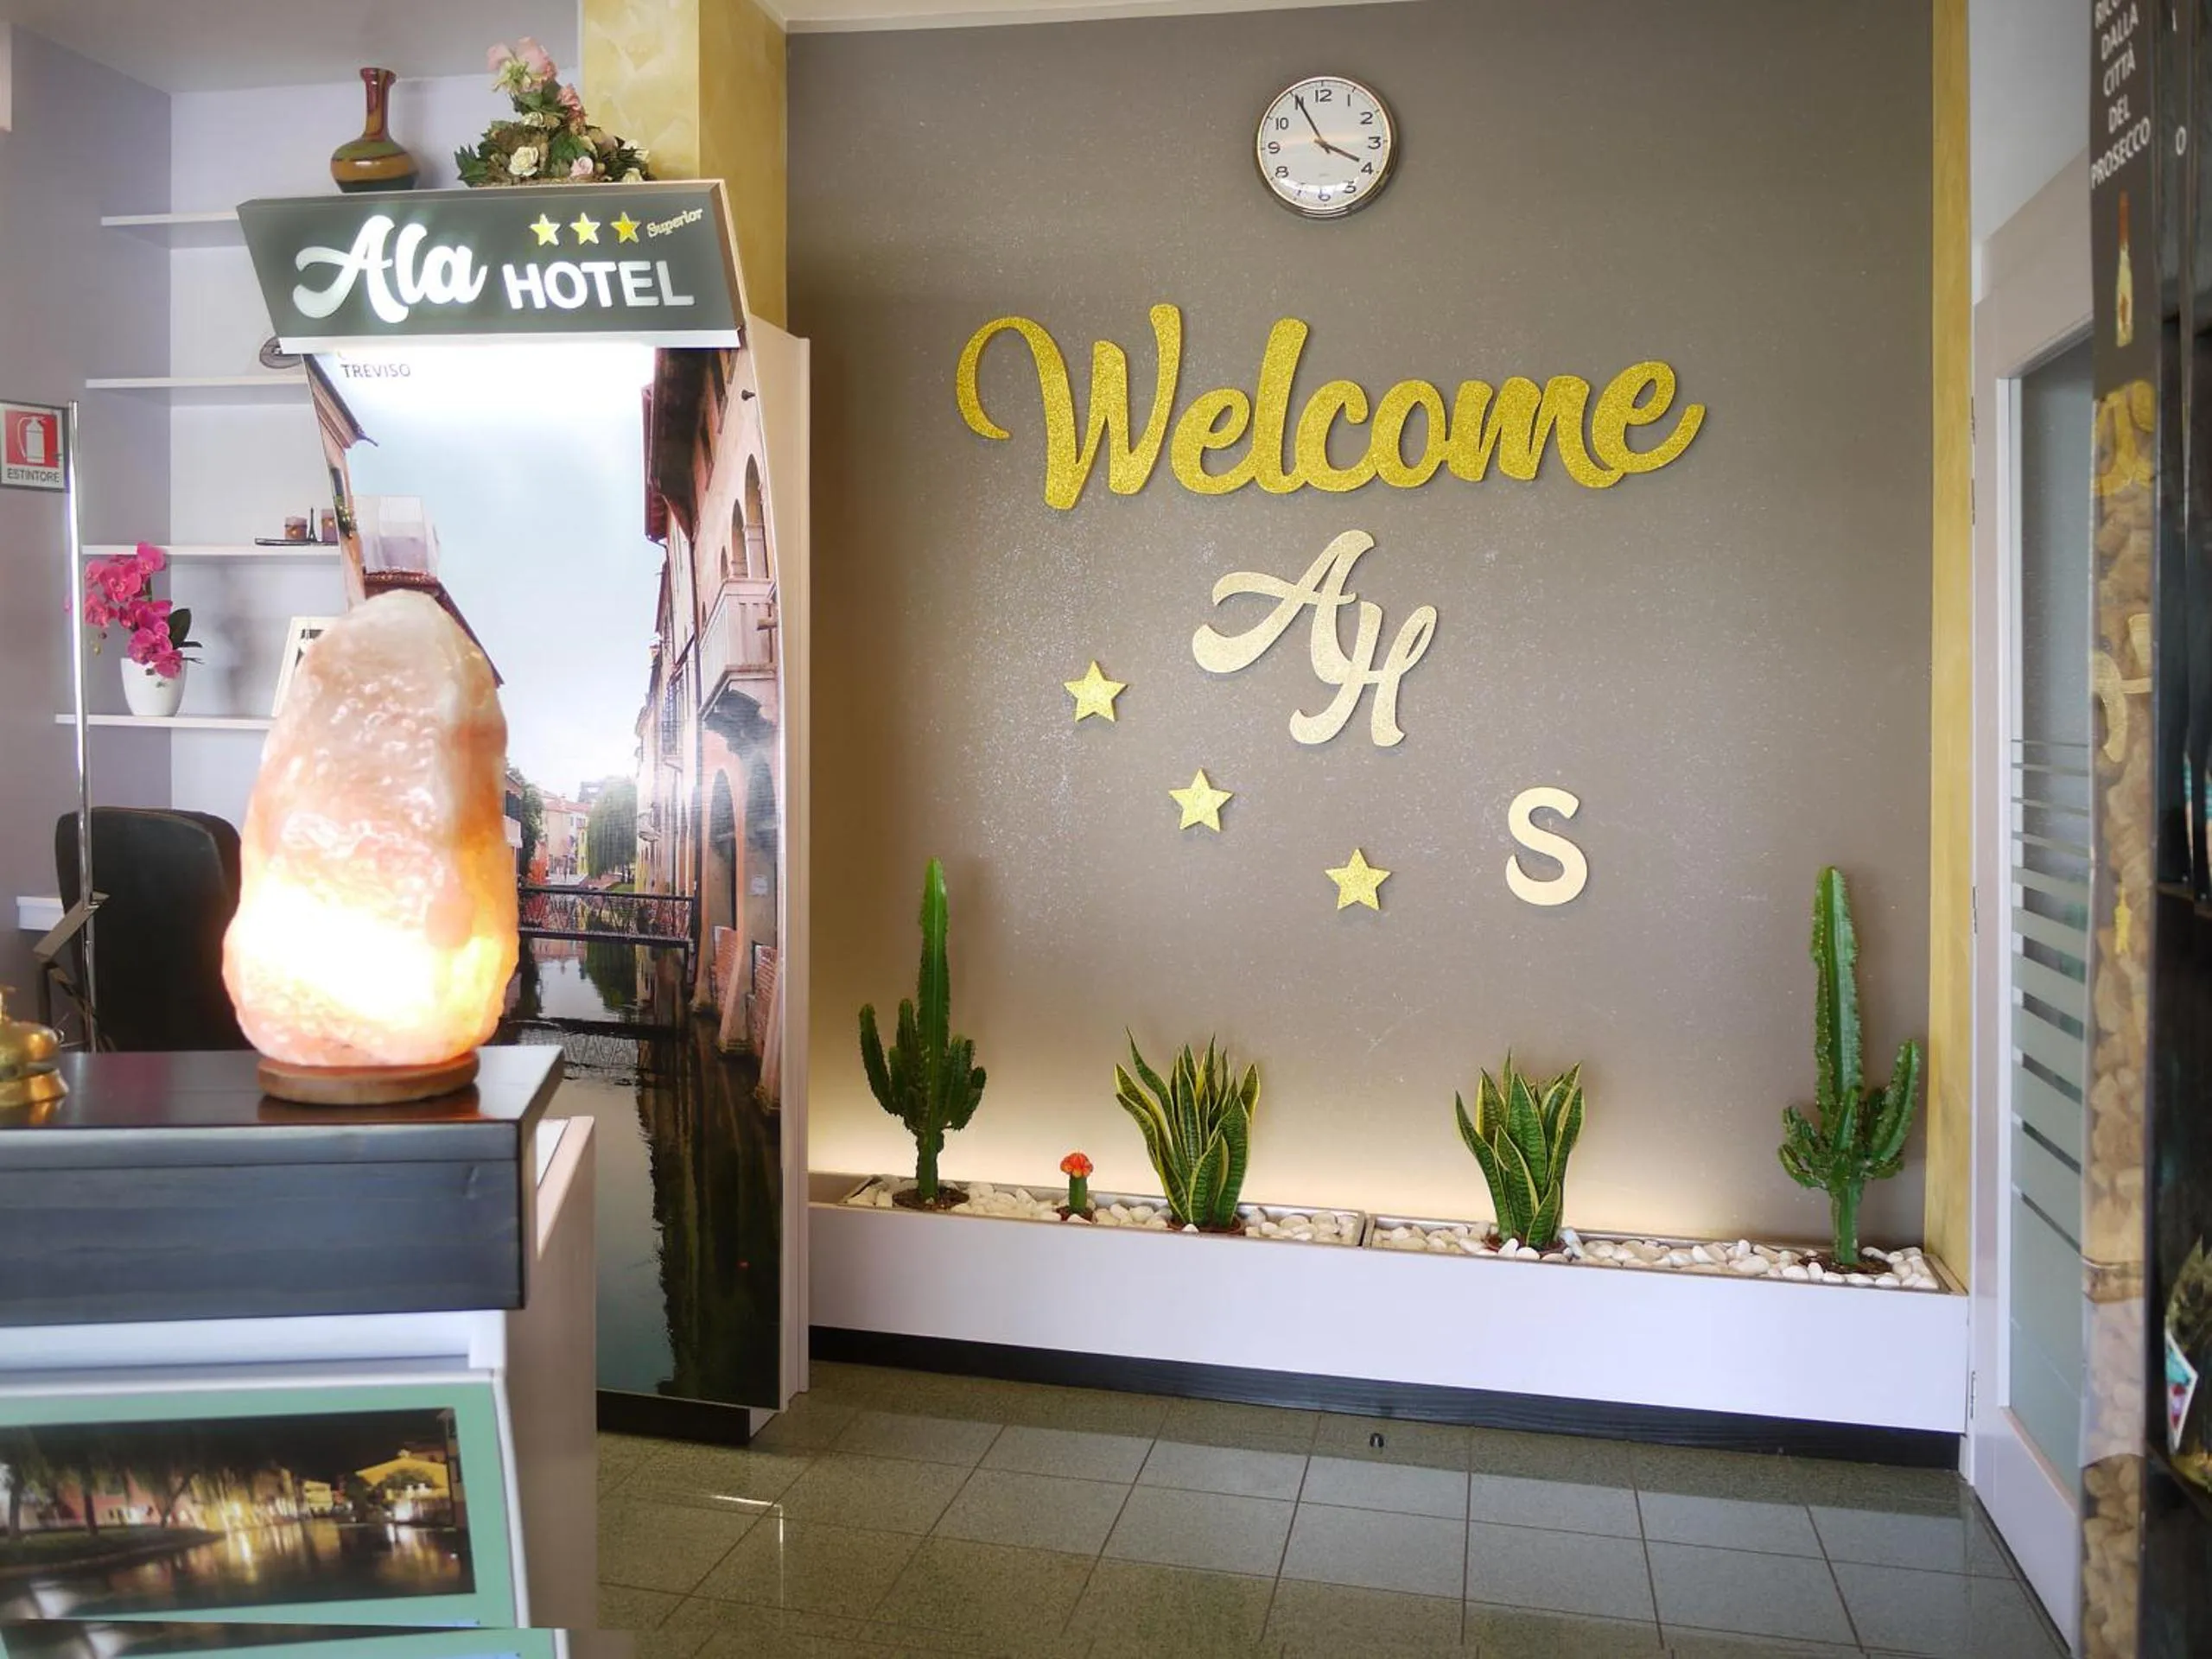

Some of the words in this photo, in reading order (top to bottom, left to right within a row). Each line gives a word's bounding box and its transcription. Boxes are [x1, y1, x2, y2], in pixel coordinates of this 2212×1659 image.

[2101, 2, 2139, 61] DALLA
[1314, 88, 1332, 103] 12
[1359, 111, 1374, 125] 2
[2107, 94, 2132, 134] DEL
[1274, 117, 1290, 130] 10
[1267, 141, 1281, 155] 9
[1367, 136, 1382, 150] 3
[2090, 116, 2152, 190] PROSECCO
[1274, 165, 1289, 179] 8
[1360, 162, 1374, 175] 4
[646, 207, 703, 238] Superior
[292, 213, 488, 324] Ala
[502, 260, 696, 310] HOTEL
[340, 363, 411, 378] TREVISO
[957, 303, 1707, 511] Welcome
[6, 467, 60, 484] ESTINTORE
[1505, 786, 1589, 906] S
